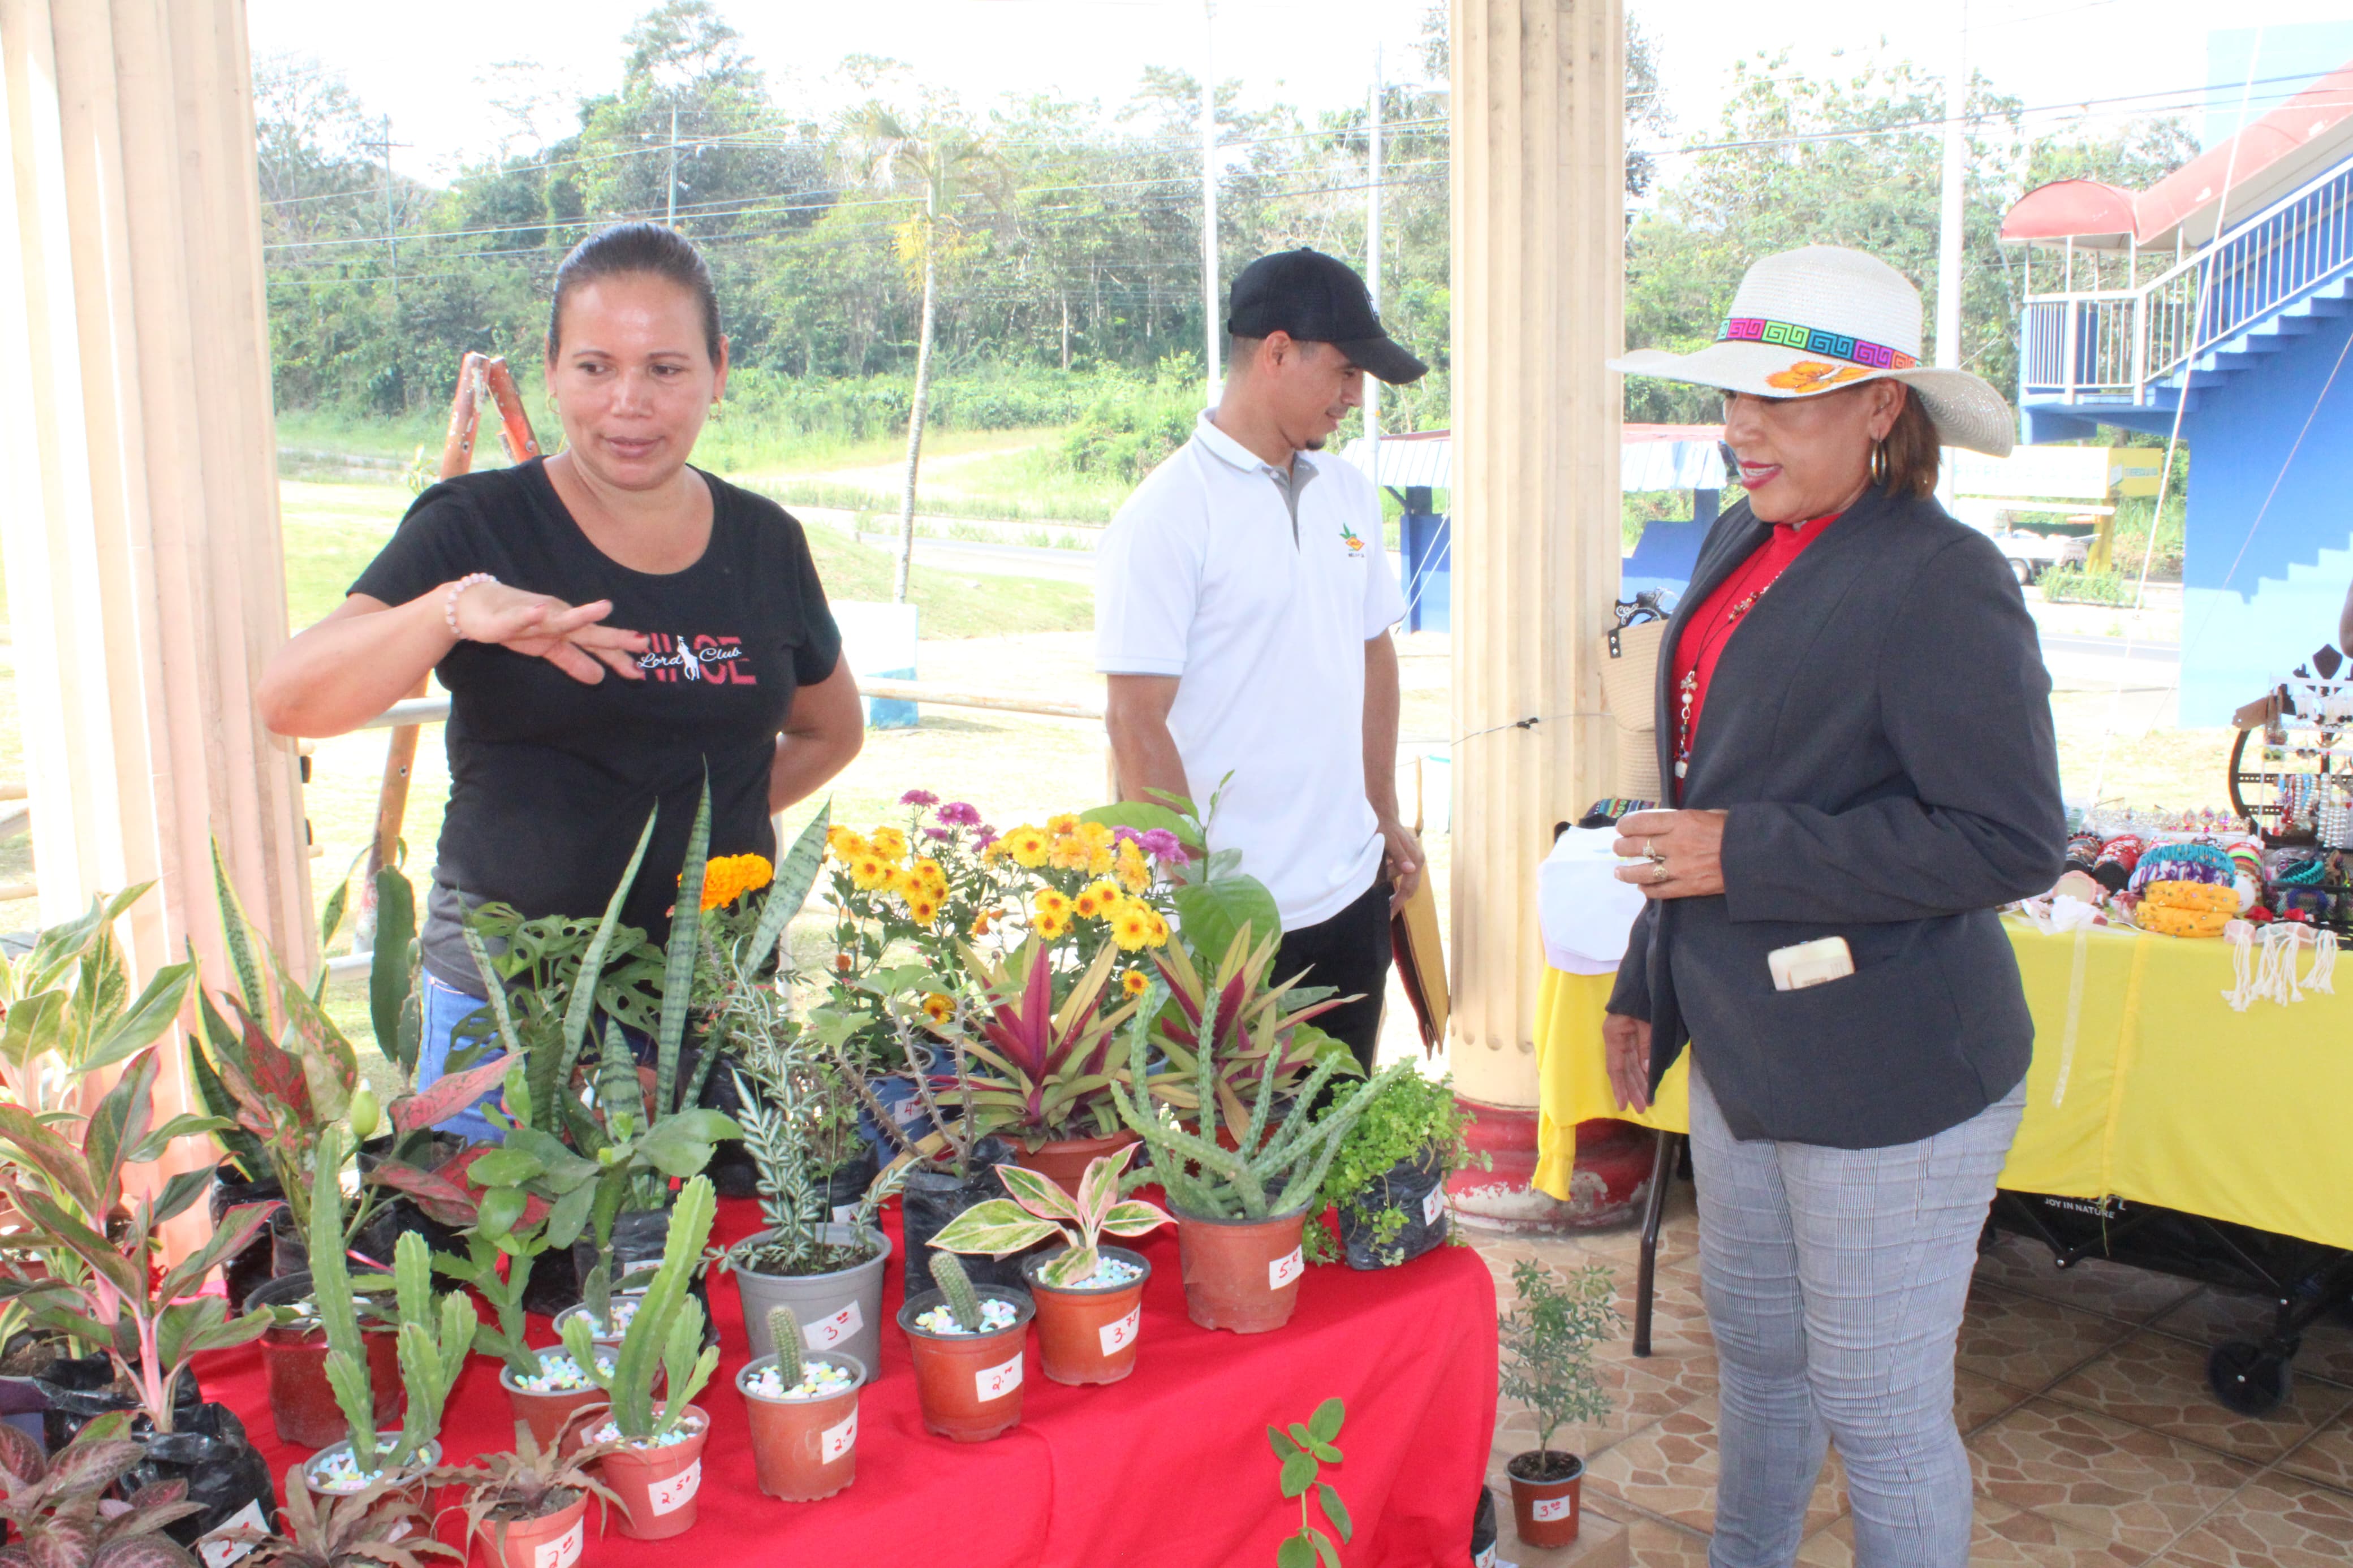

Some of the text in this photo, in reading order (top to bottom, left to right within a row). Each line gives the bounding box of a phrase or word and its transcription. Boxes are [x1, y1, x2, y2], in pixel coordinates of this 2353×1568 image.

[637, 647, 742, 668] Lord Club
[2044, 1198, 2061, 1208] JOY
[2063, 1201, 2074, 1210] IN
[2075, 1203, 2115, 1219] NATURE
